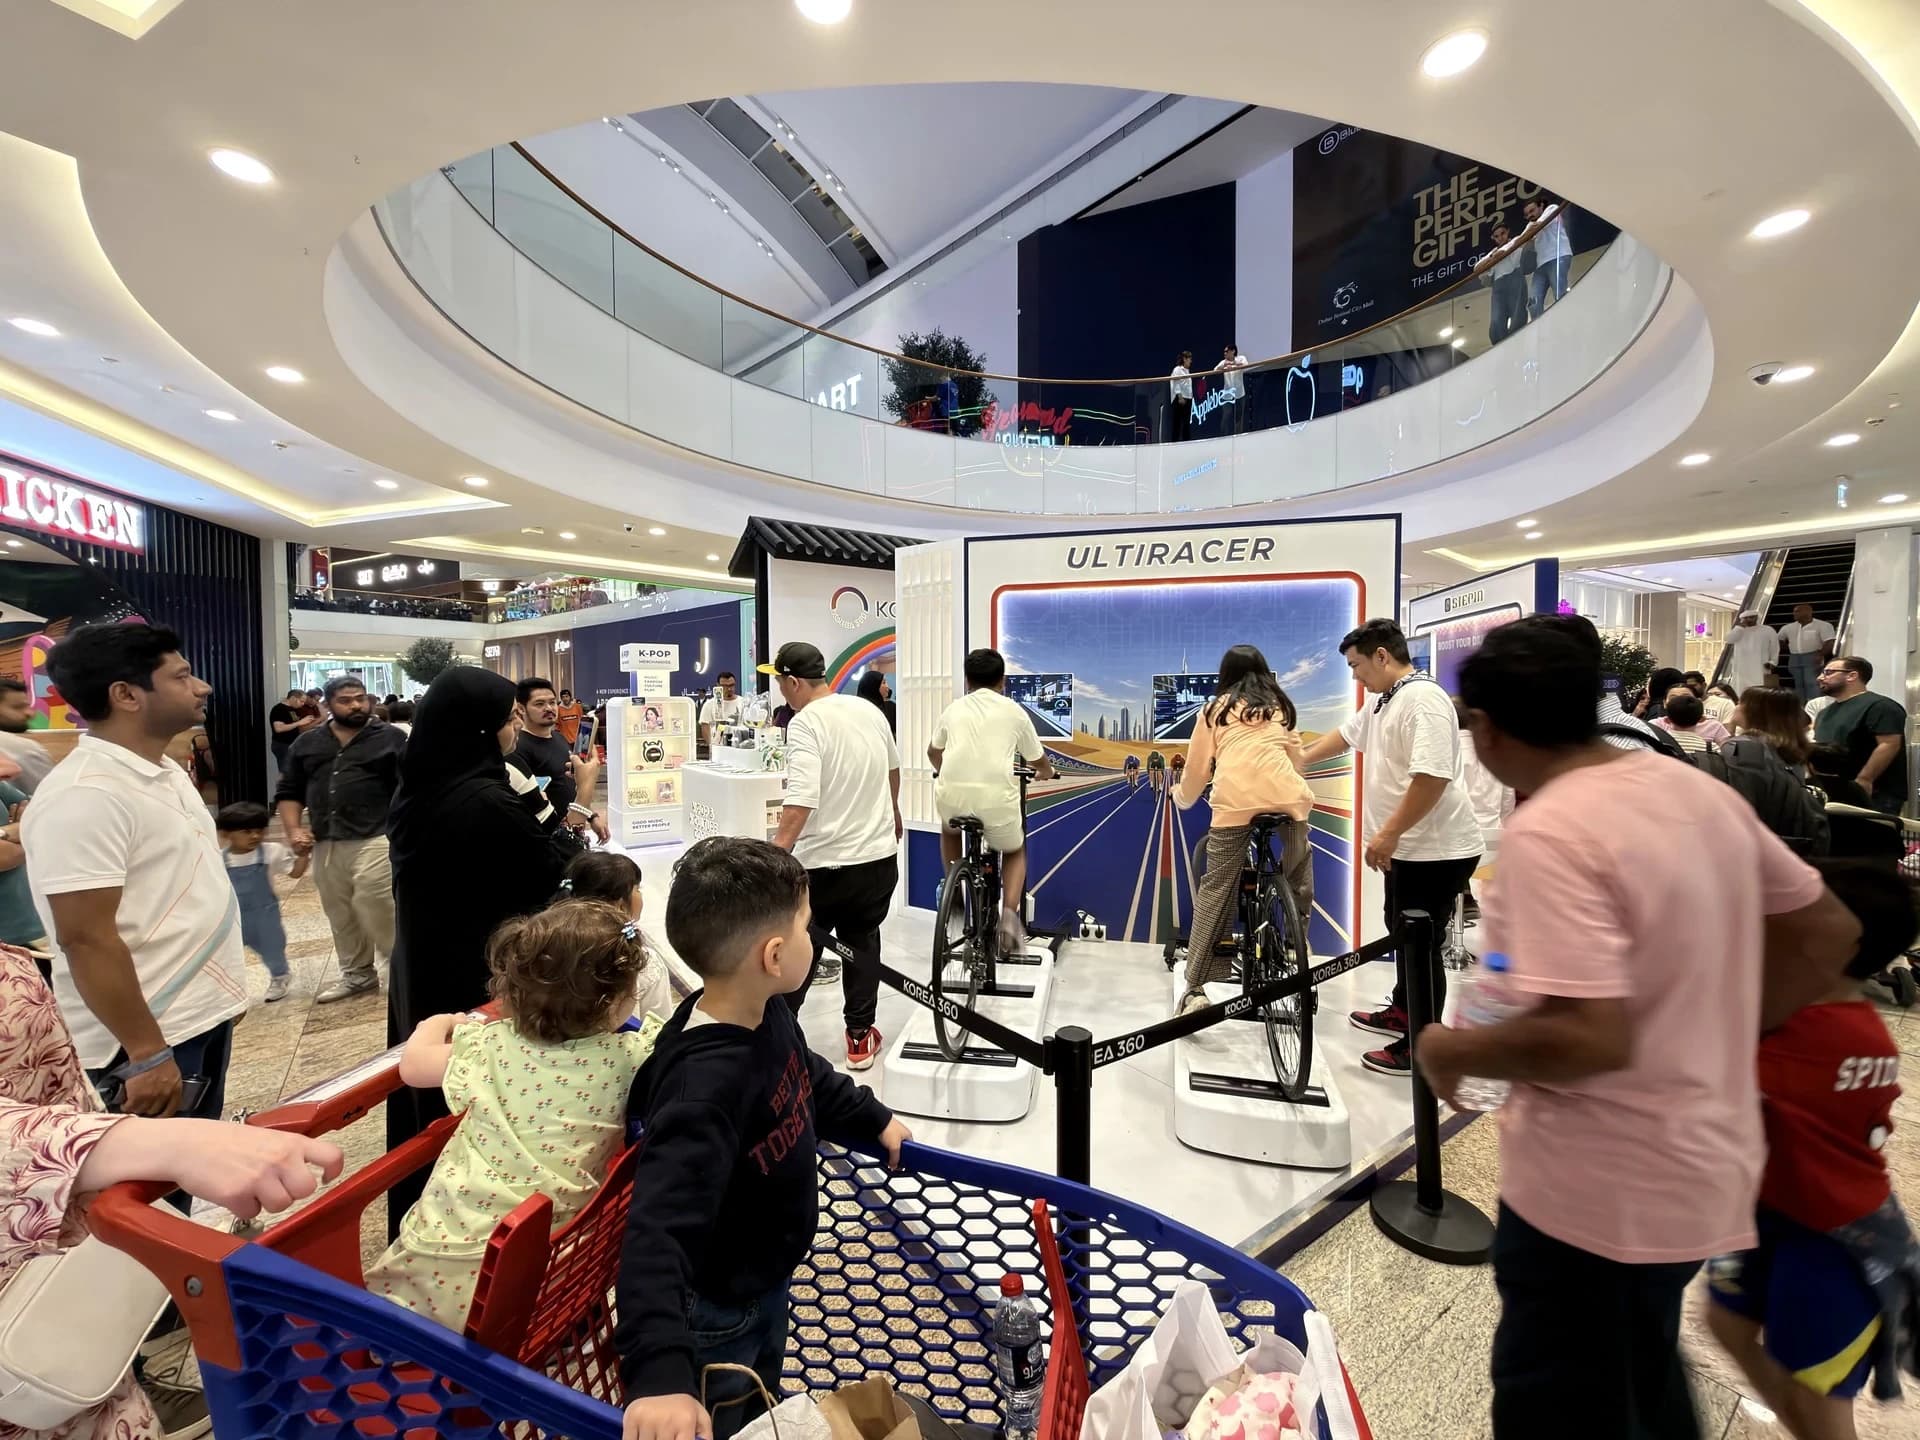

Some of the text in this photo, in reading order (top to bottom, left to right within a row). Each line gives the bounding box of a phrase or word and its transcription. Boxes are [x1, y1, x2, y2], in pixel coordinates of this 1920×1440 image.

[1412, 166, 1479, 217] THE
[1411, 271, 1435, 289] THE
[1437, 260, 1464, 279] GIFT
[806, 373, 862, 411] ART
[1067, 537, 1276, 569] ULTIRACER
[638, 649, 671, 658] K-POP
[903, 979, 959, 1020] KOREA 360
[1117, 1034, 1145, 1057] 360
[1224, 997, 1253, 1016] KOCCA
[1312, 960, 1343, 984] KOREA
[1343, 952, 1361, 970] 360
